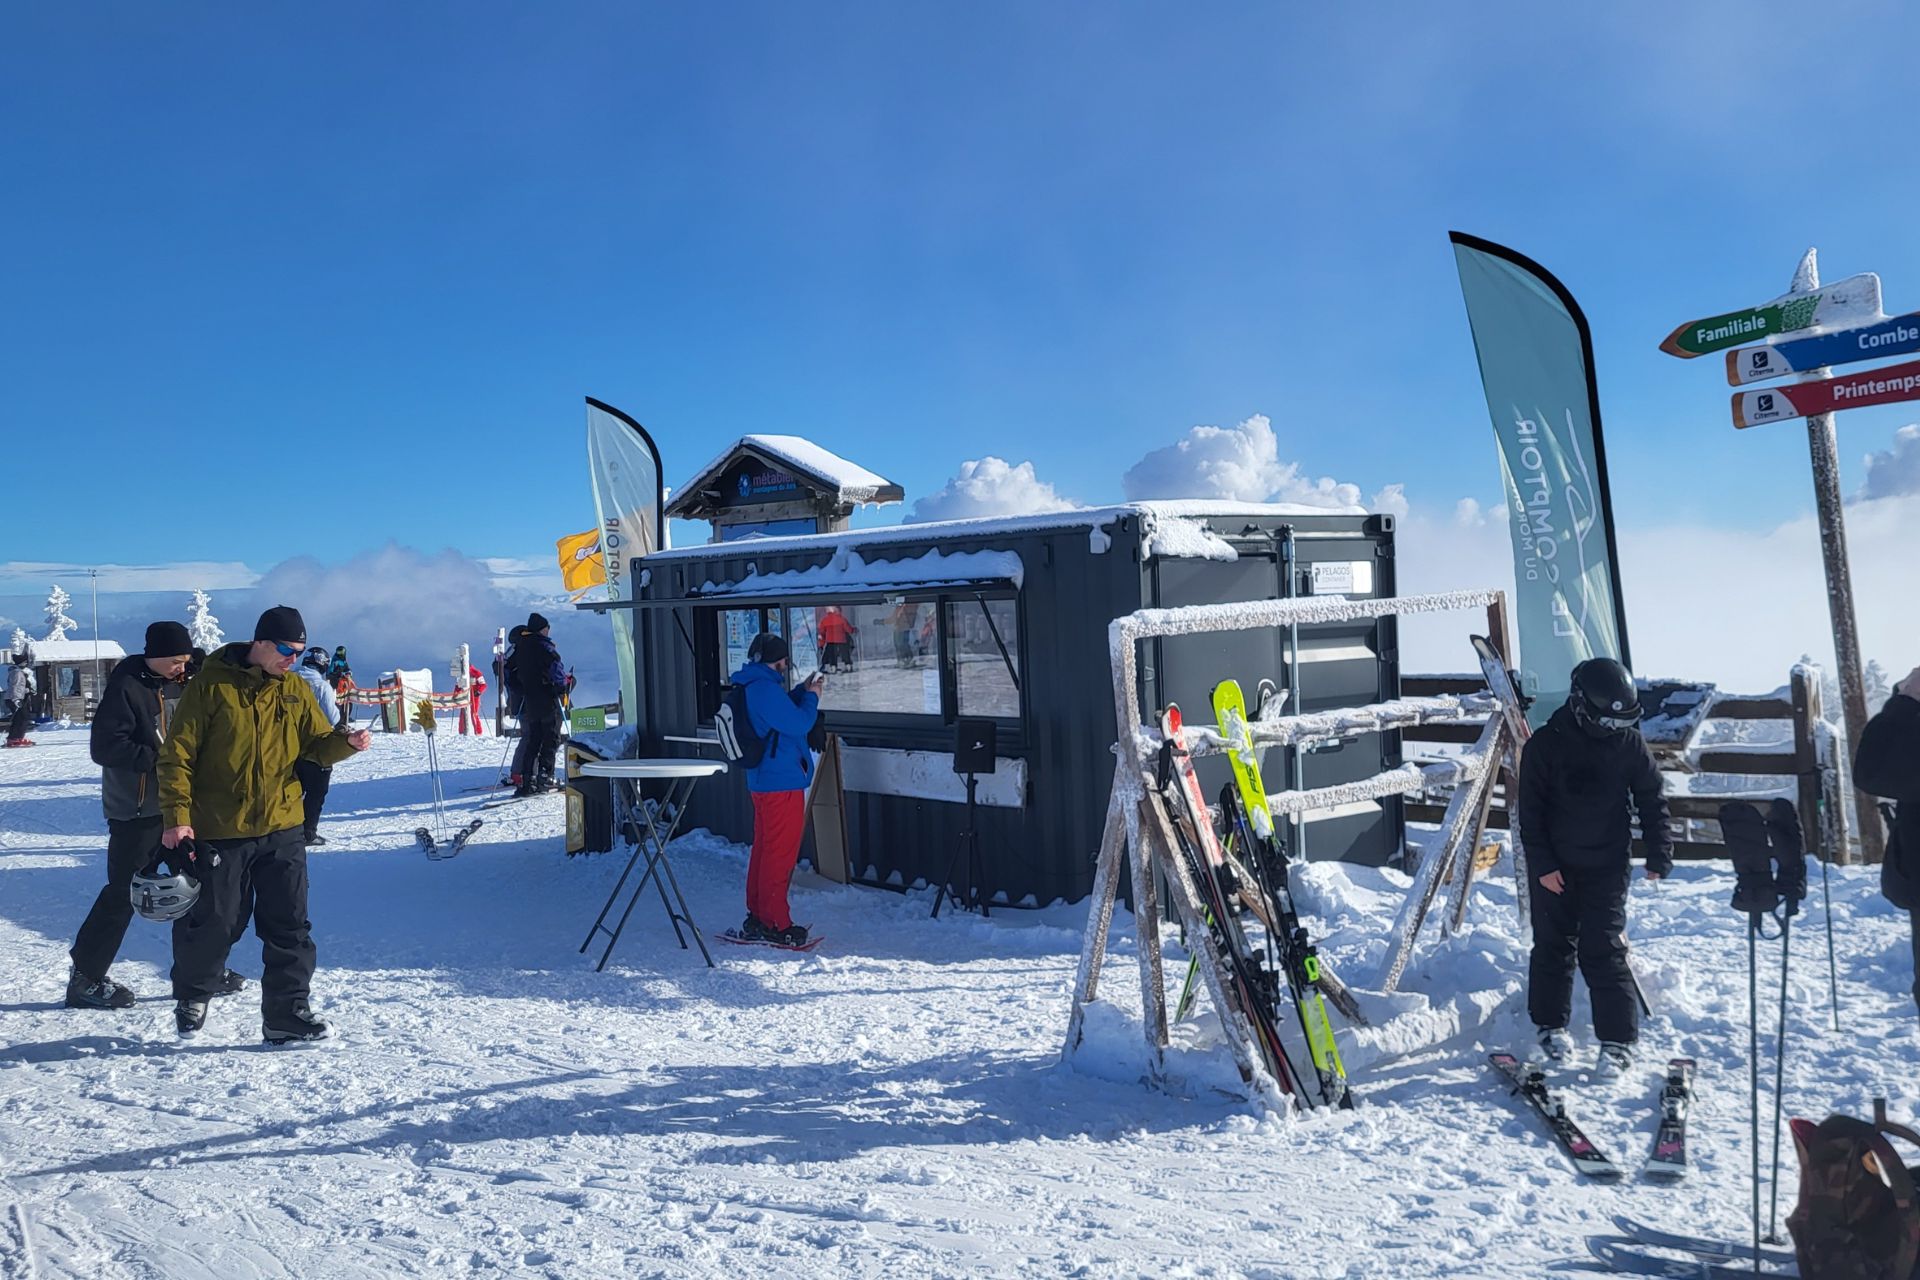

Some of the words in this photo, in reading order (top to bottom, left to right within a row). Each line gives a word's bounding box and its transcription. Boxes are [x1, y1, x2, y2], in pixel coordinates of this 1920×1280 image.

[1696, 315, 1767, 344] Familiale
[1858, 326, 1919, 349] Combe
[1833, 374, 1920, 400] Printemps
